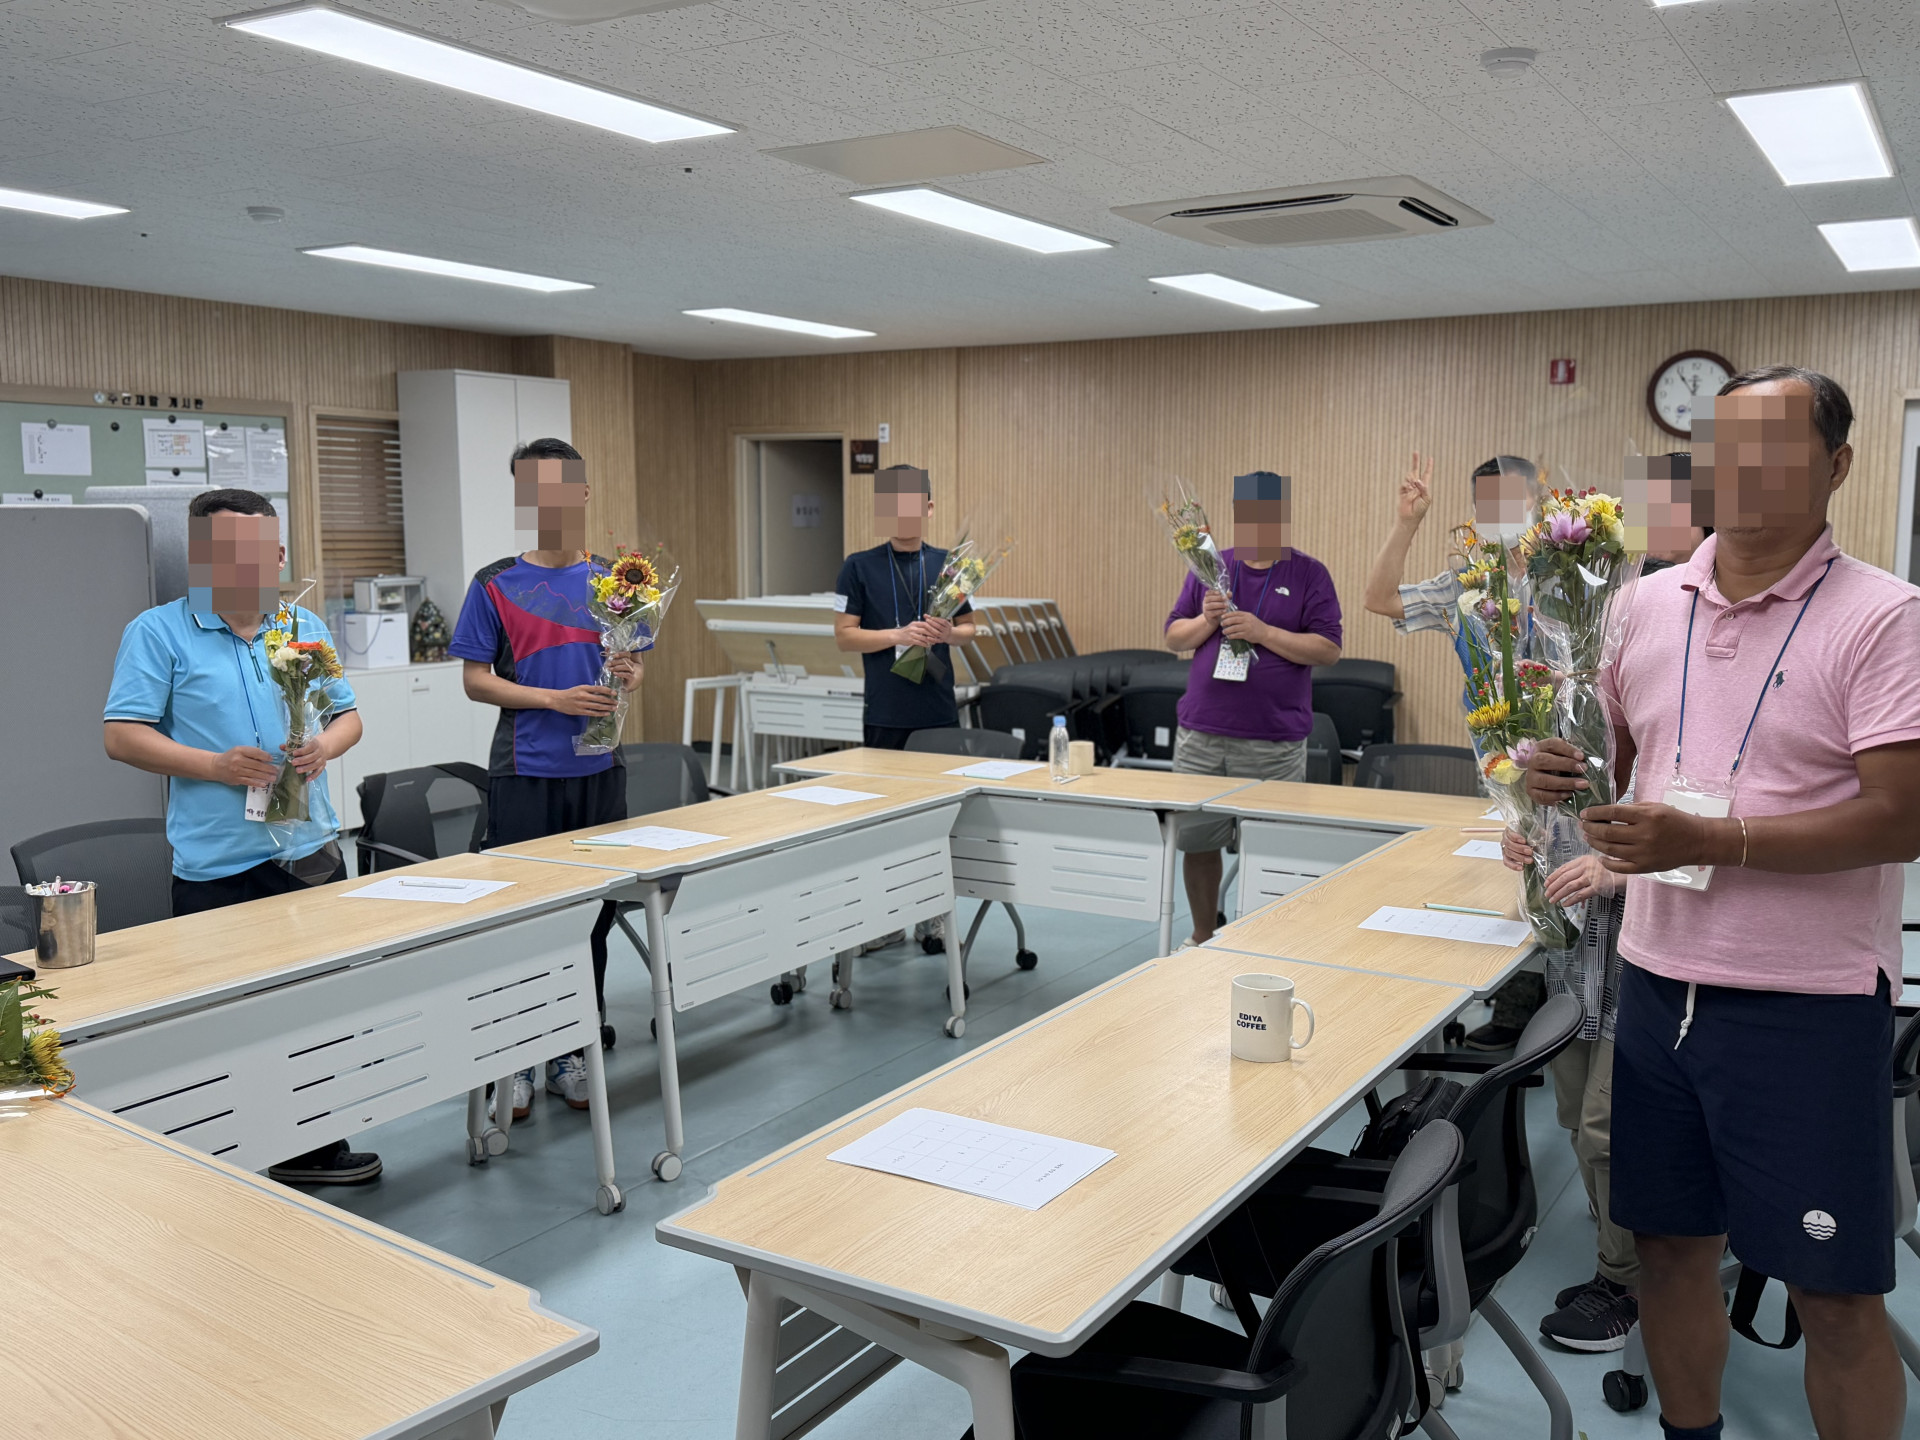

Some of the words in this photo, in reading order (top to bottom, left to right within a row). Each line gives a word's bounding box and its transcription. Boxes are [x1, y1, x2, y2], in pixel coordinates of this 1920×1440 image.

[169, 396, 203, 410] 게시판
[1239, 1012, 1263, 1022] EDIYA
[1236, 1020, 1266, 1030] COFFEE
